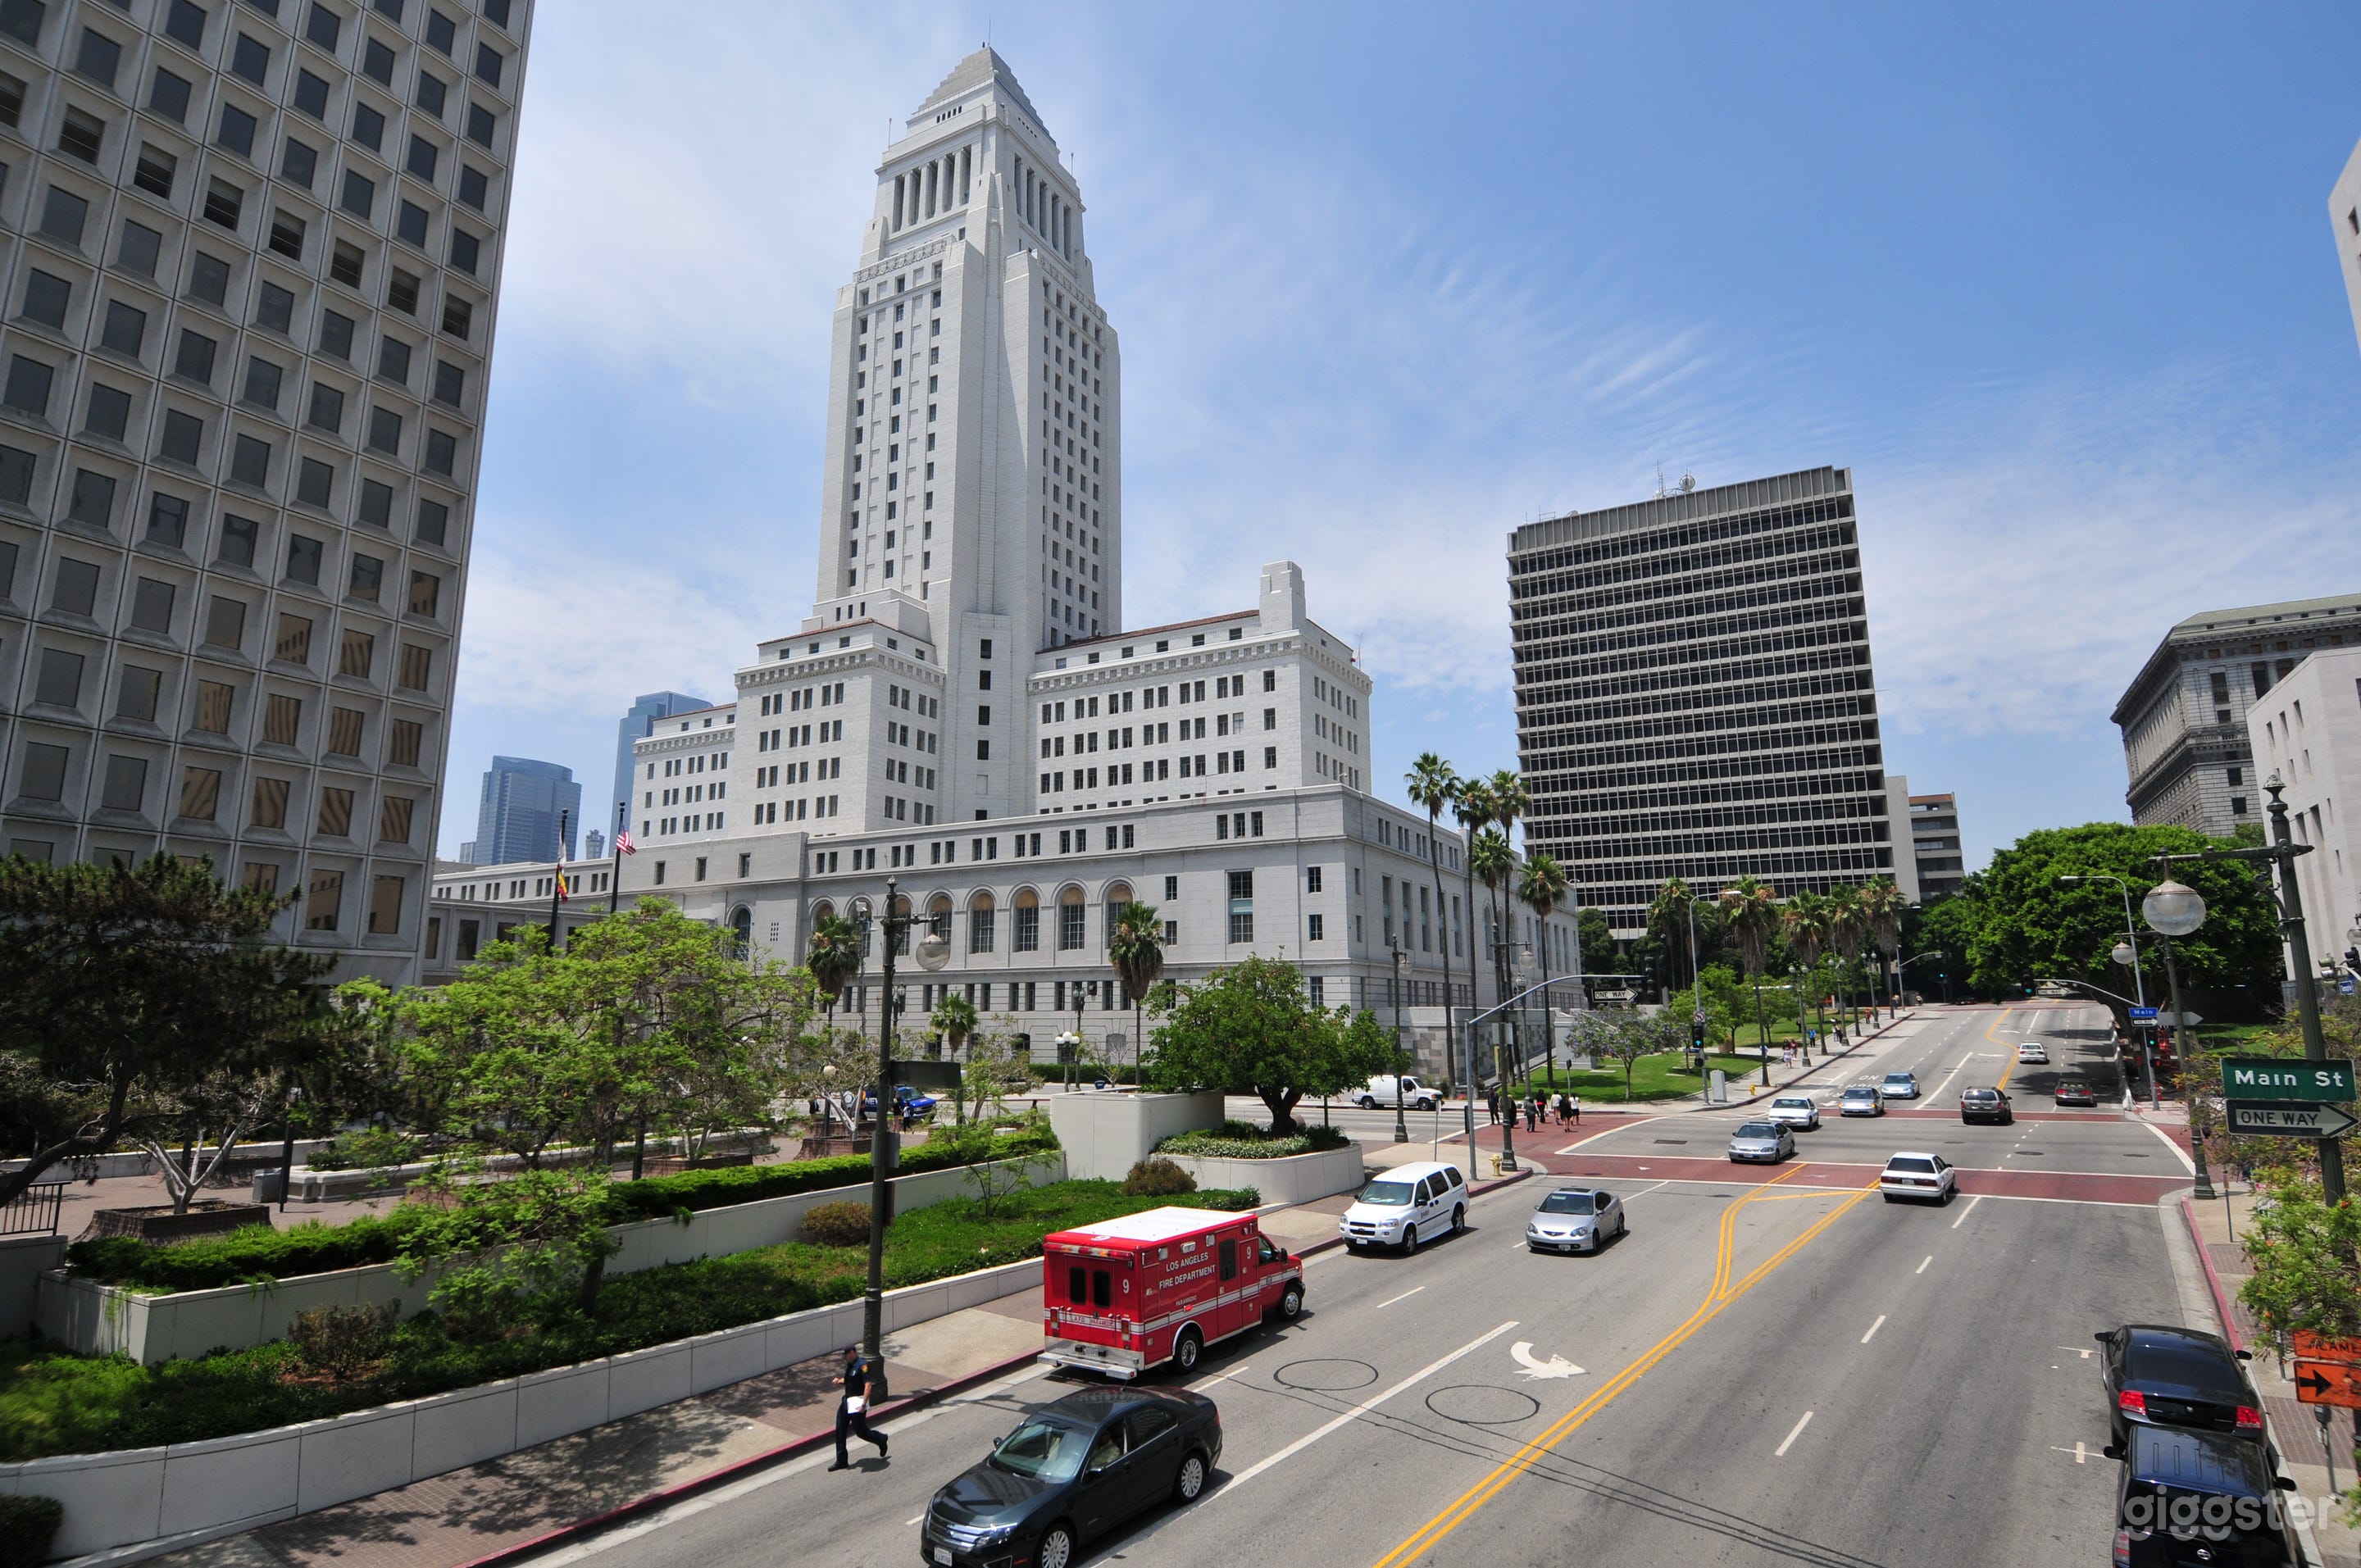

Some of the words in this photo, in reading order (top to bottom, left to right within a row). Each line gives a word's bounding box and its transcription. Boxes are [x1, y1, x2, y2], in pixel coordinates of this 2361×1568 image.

[2234, 1070, 2297, 1086] Main
[2314, 1070, 2344, 1087] St
[2240, 1111, 2277, 1125] ONE
[2281, 1112, 2318, 1126] WAY
[1246, 1246, 1252, 1260] 9
[1166, 1261, 1180, 1272] LOS
[1180, 1252, 1209, 1268] ANGELES
[1158, 1277, 1174, 1290] FIRE
[1174, 1264, 1216, 1285] DEPARTMENT
[1122, 1279, 1130, 1294] 9
